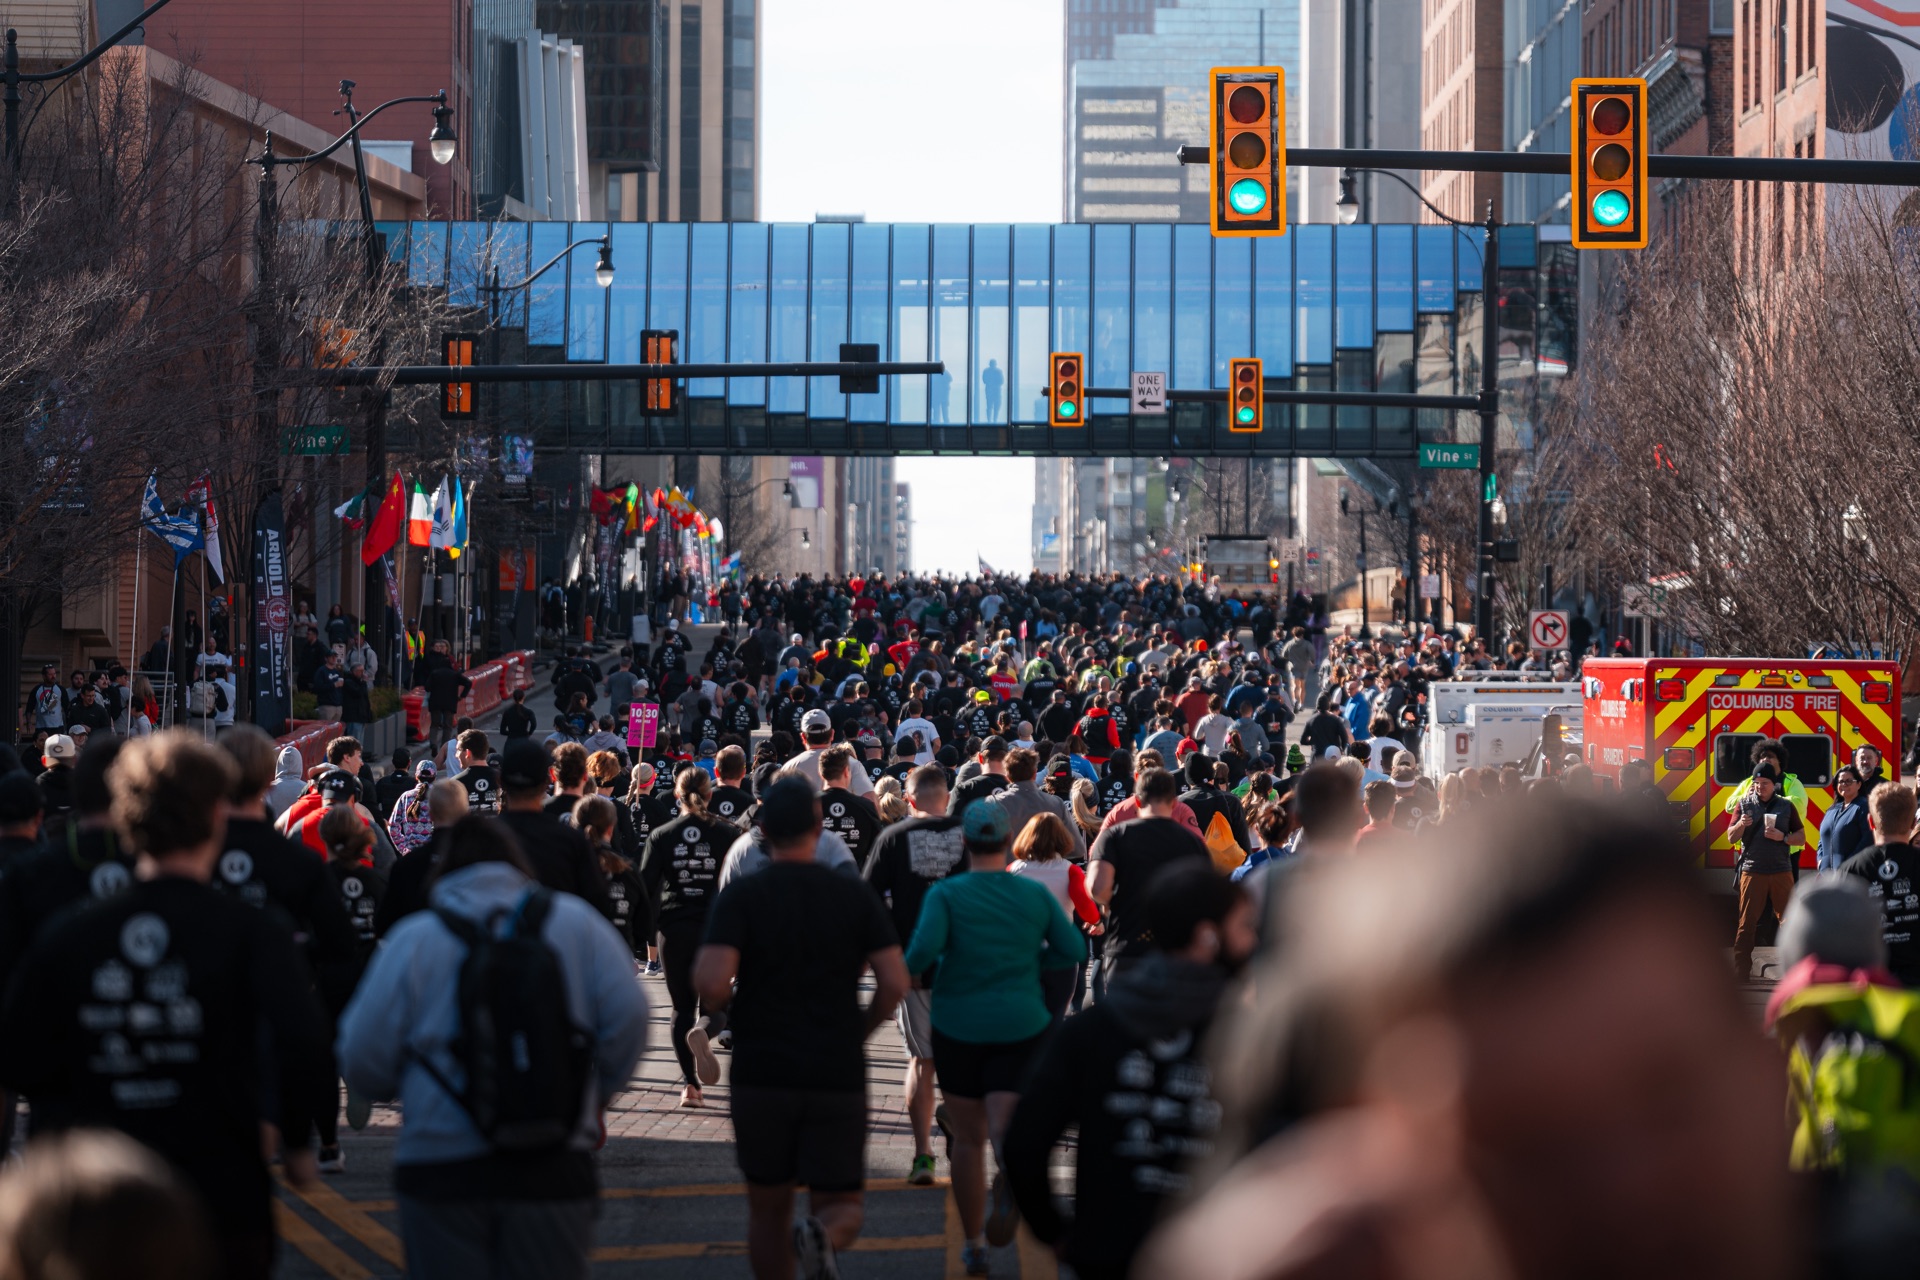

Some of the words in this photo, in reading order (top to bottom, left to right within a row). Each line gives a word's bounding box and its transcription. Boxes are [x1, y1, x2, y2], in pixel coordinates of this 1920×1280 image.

[1138, 375, 1160, 385] ONE
[1137, 386, 1160, 396] WAY
[1427, 448, 1460, 463] Vine
[1464, 452, 1473, 461] St
[1283, 550, 1298, 559] 25
[267, 528, 284, 597] ARNOLD
[256, 529, 270, 697] FESTIVAL
[1710, 693, 1795, 710] COLUMBUS
[1804, 695, 1837, 710] FIRE
[631, 707, 658, 718] 1030
